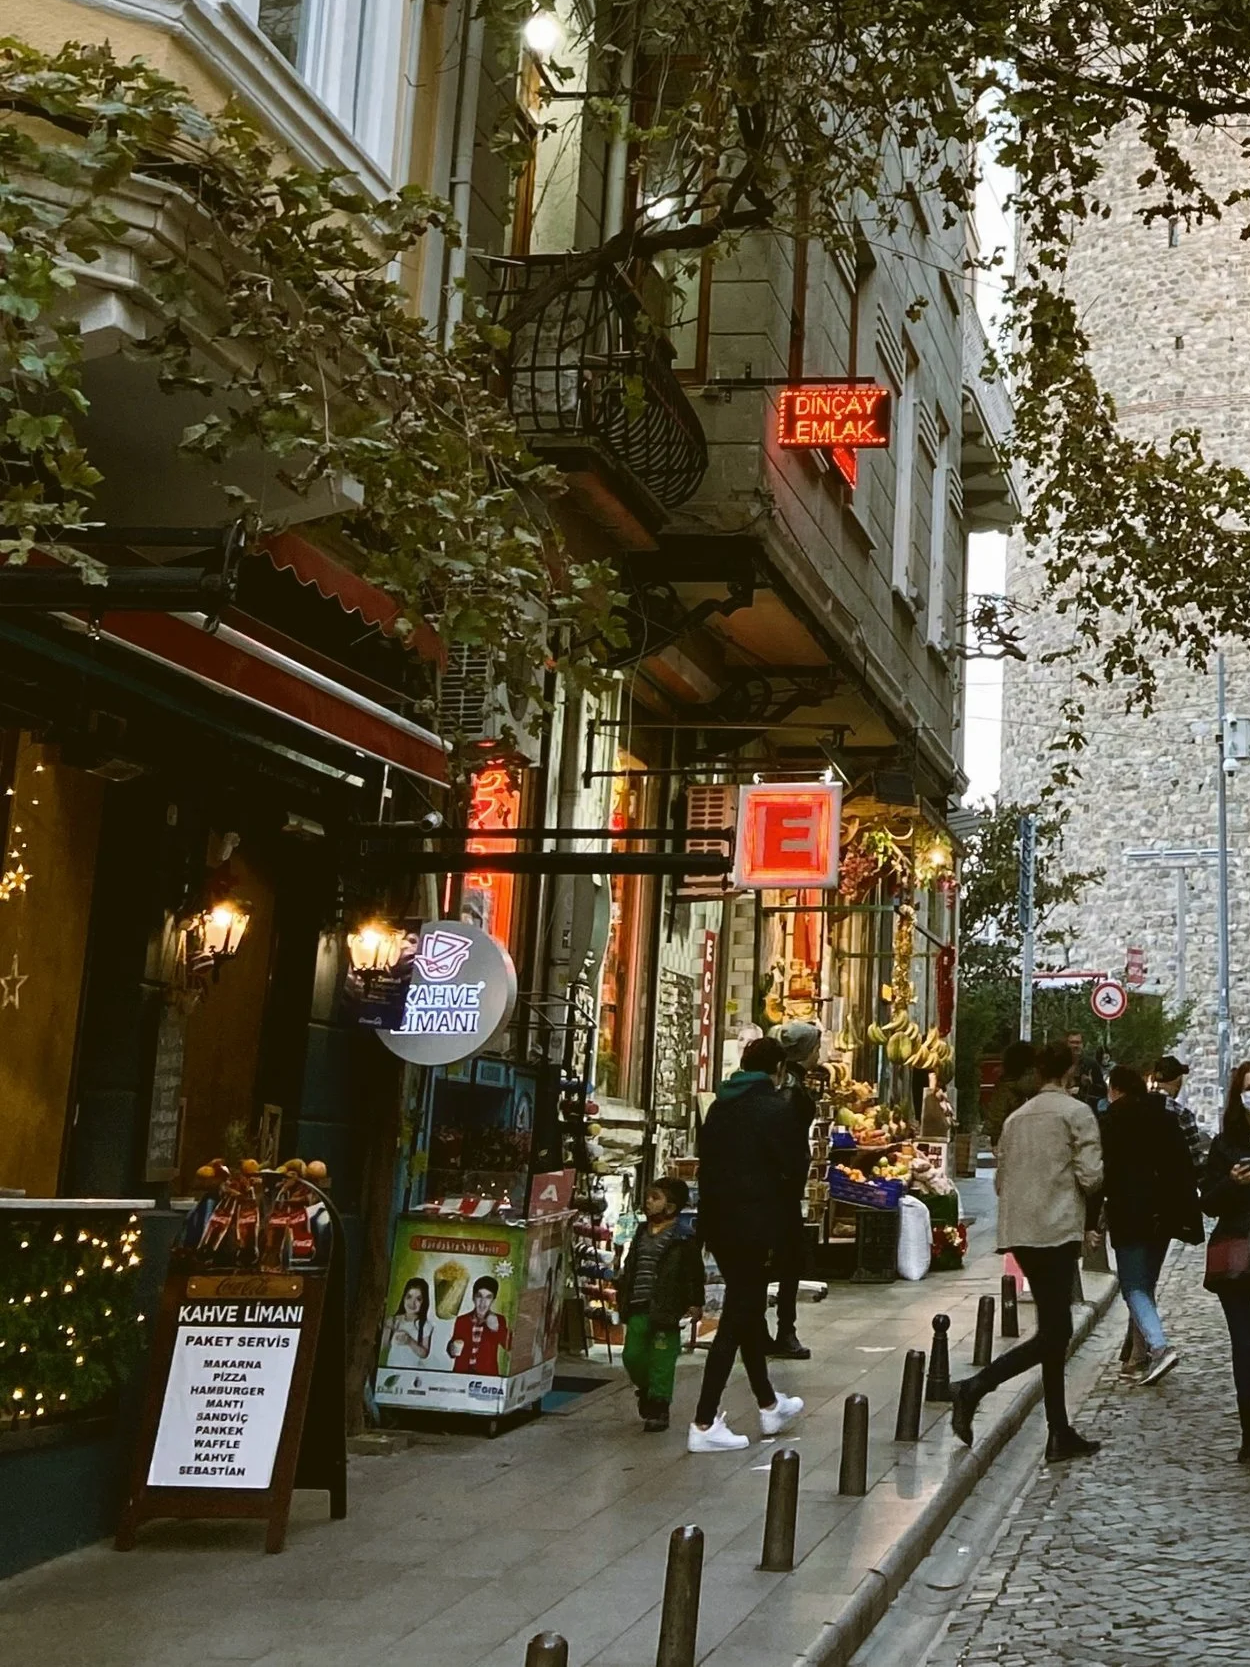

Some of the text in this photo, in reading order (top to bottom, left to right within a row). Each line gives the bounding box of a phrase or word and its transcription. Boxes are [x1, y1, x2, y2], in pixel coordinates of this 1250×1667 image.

[795, 393, 877, 420] DİNÇAY
[795, 420, 876, 440] EMLAK
[763, 805, 813, 869] E
[178, 1301, 304, 1323] KAHVE LİMANI
[185, 1334, 291, 1348] PAKET SERVİS
[203, 1359, 262, 1369] MAKARNA
[213, 1371, 247, 1382] PİZZA
[190, 1386, 265, 1396] HAMBURGER
[205, 1399, 244, 1409] MANTI
[196, 1411, 249, 1423] SANDVİÇ
[195, 1426, 244, 1436] PANKEK
[194, 1439, 241, 1449] WAFFLE
[194, 1453, 236, 1463] KAHVE
[178, 1465, 246, 1477] SEBASTİAN
